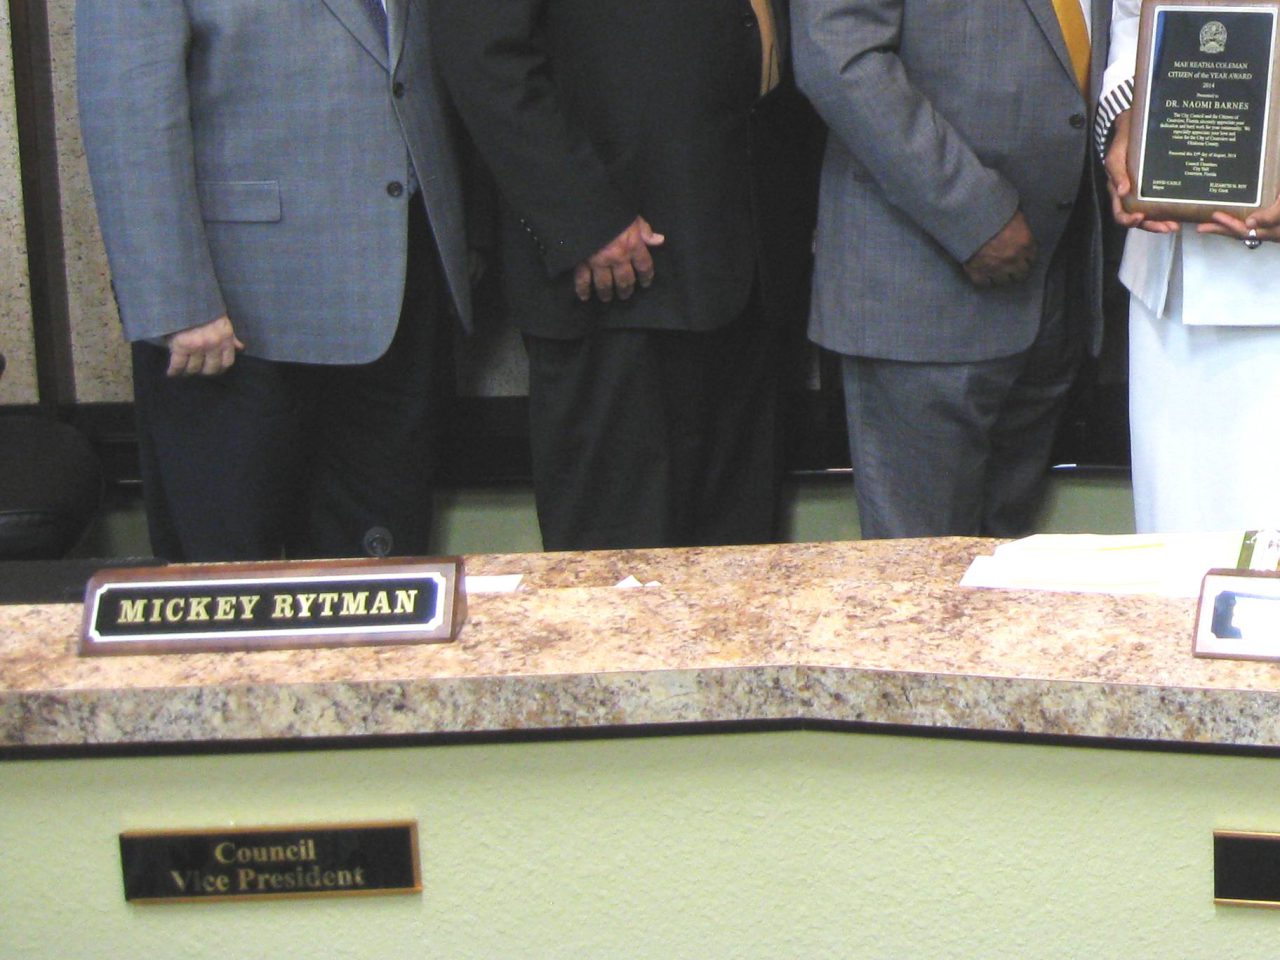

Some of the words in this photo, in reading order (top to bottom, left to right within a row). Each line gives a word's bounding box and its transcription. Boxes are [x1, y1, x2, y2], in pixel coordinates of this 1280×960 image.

[1166, 100, 1179, 108] DR.
[1183, 101, 1212, 109] NAOMI
[1215, 101, 1249, 110] BARNES
[117, 594, 260, 624] MICKEY
[271, 589, 418, 619] RYTMAN
[214, 839, 316, 865] Council
[170, 869, 230, 891] Vice
[238, 865, 366, 890] President
